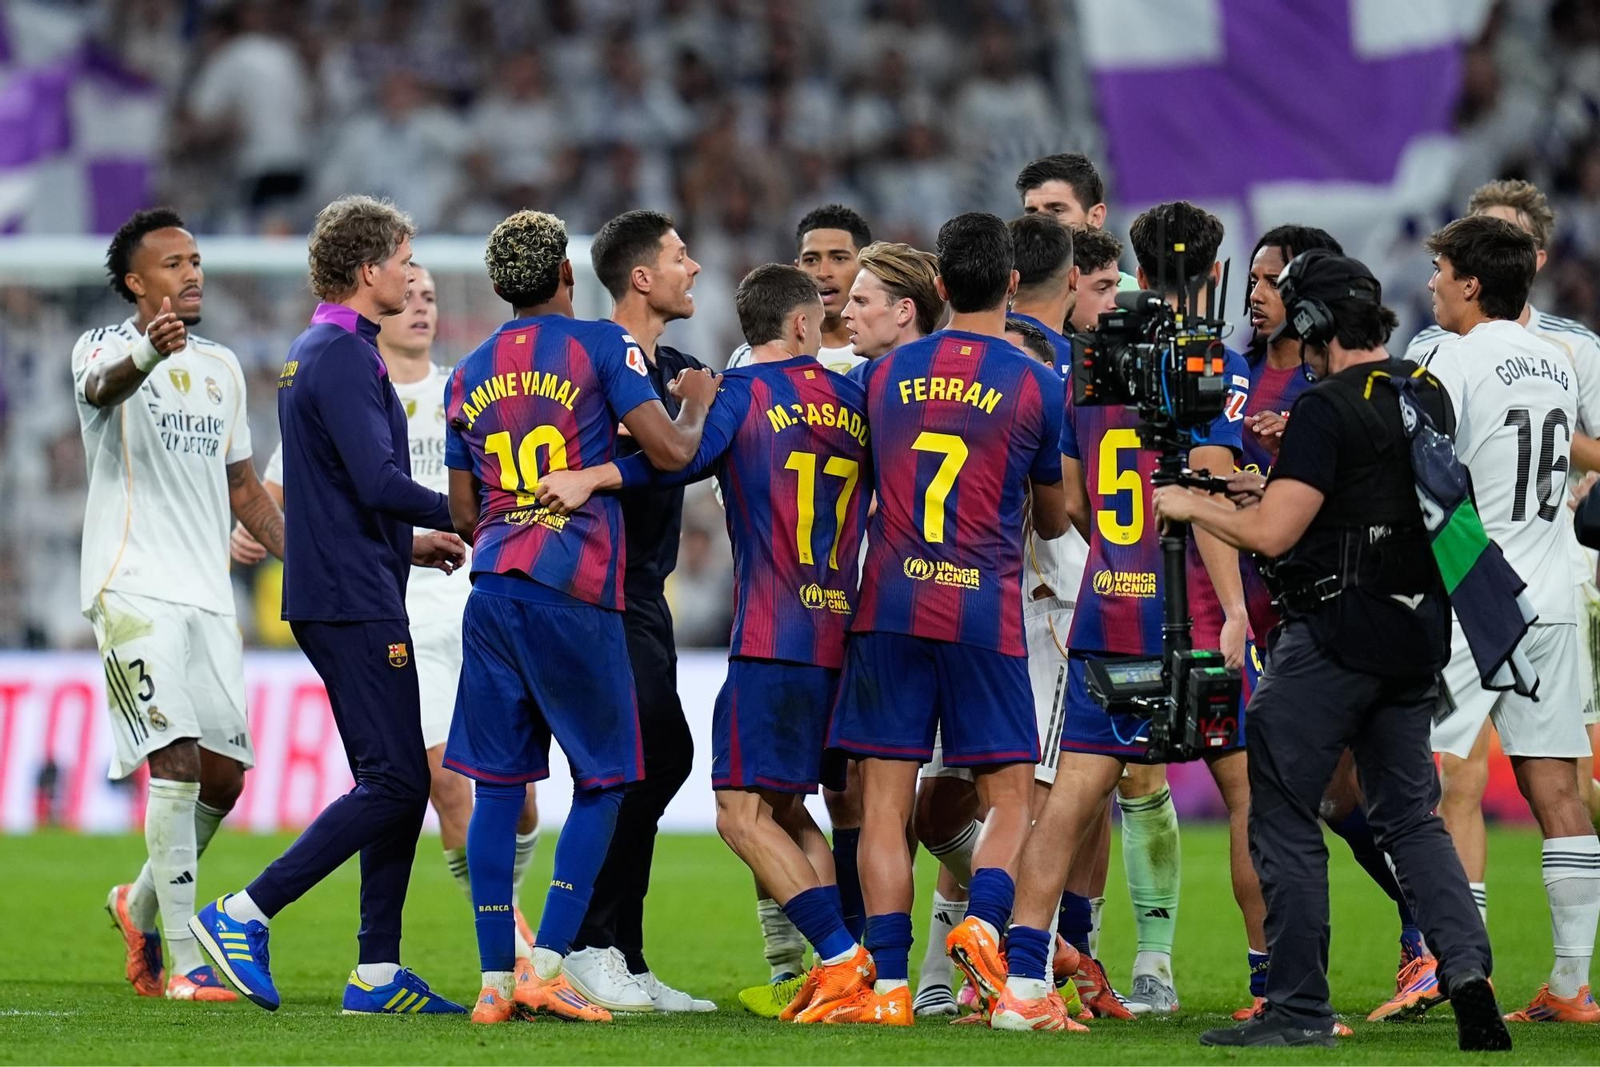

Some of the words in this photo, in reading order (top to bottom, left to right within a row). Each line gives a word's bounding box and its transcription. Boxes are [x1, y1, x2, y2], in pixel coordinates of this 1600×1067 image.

[1495, 356, 1569, 391] GONZALO
[462, 373, 517, 430] AMINE
[521, 371, 580, 411] YAMAL
[899, 377, 1002, 414] FERRAN
[485, 425, 567, 507] 10
[1504, 408, 1570, 522] 16
[911, 431, 969, 543] 7
[1097, 429, 1143, 545] 5
[784, 450, 859, 570] 17
[935, 572, 980, 586] ACNUR
[936, 561, 979, 578] UNHCR
[1114, 572, 1156, 583] UNHCR
[1114, 582, 1156, 593] ACNUR
[826, 589, 846, 600] NHC
[828, 600, 851, 611] CNU
[129, 658, 155, 702] 3
